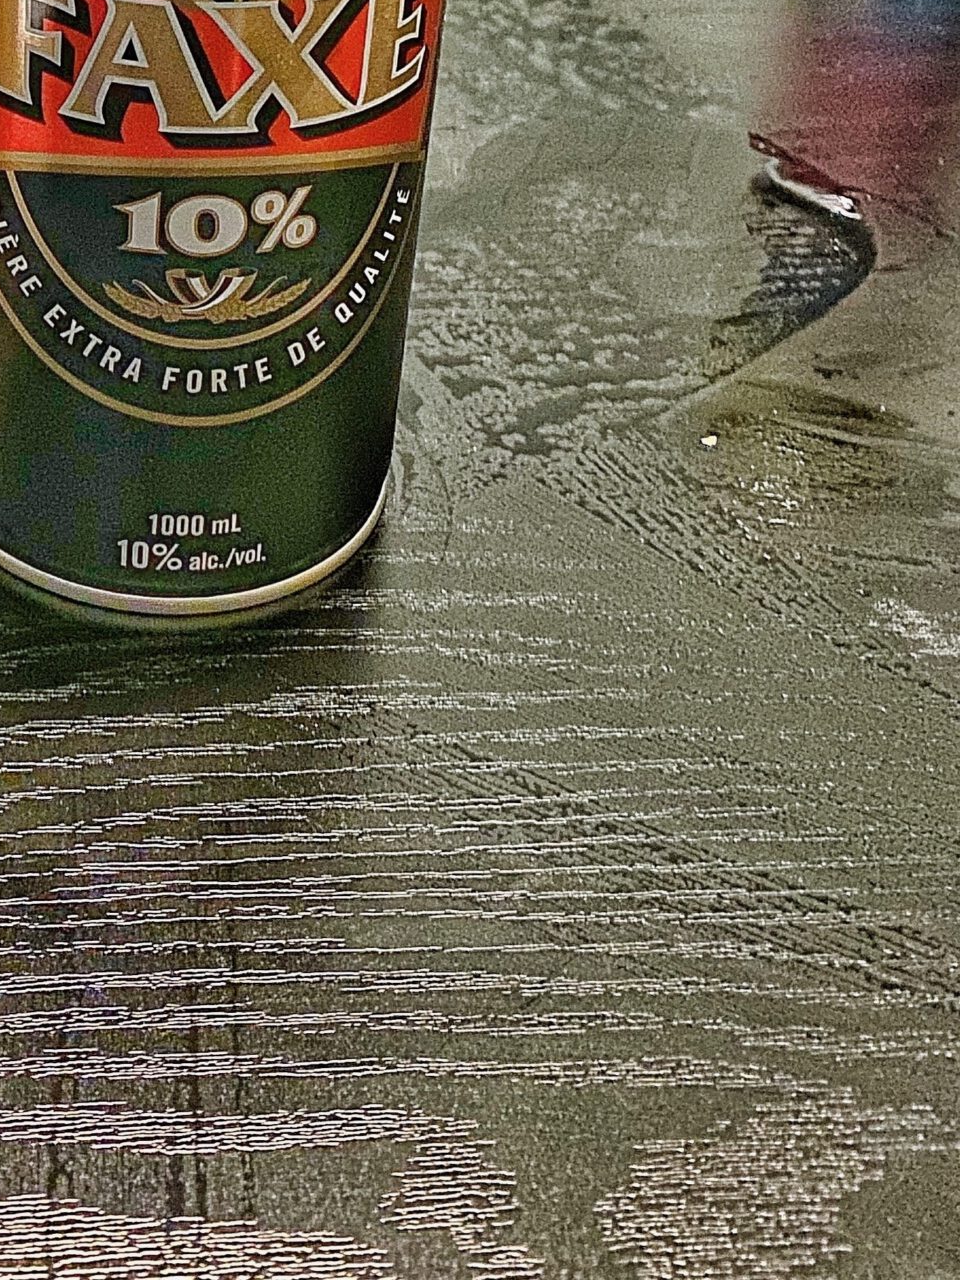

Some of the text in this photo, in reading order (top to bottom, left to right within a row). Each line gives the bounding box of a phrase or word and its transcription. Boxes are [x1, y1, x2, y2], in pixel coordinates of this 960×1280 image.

[113, 184, 318, 258] 10%
[42, 303, 142, 385] EXTRA
[160, 357, 273, 394] FORTE
[287, 326, 327, 366] DE
[148, 512, 242, 537] 1000 mL
[116, 538, 267, 572] 10% alc./vol.
